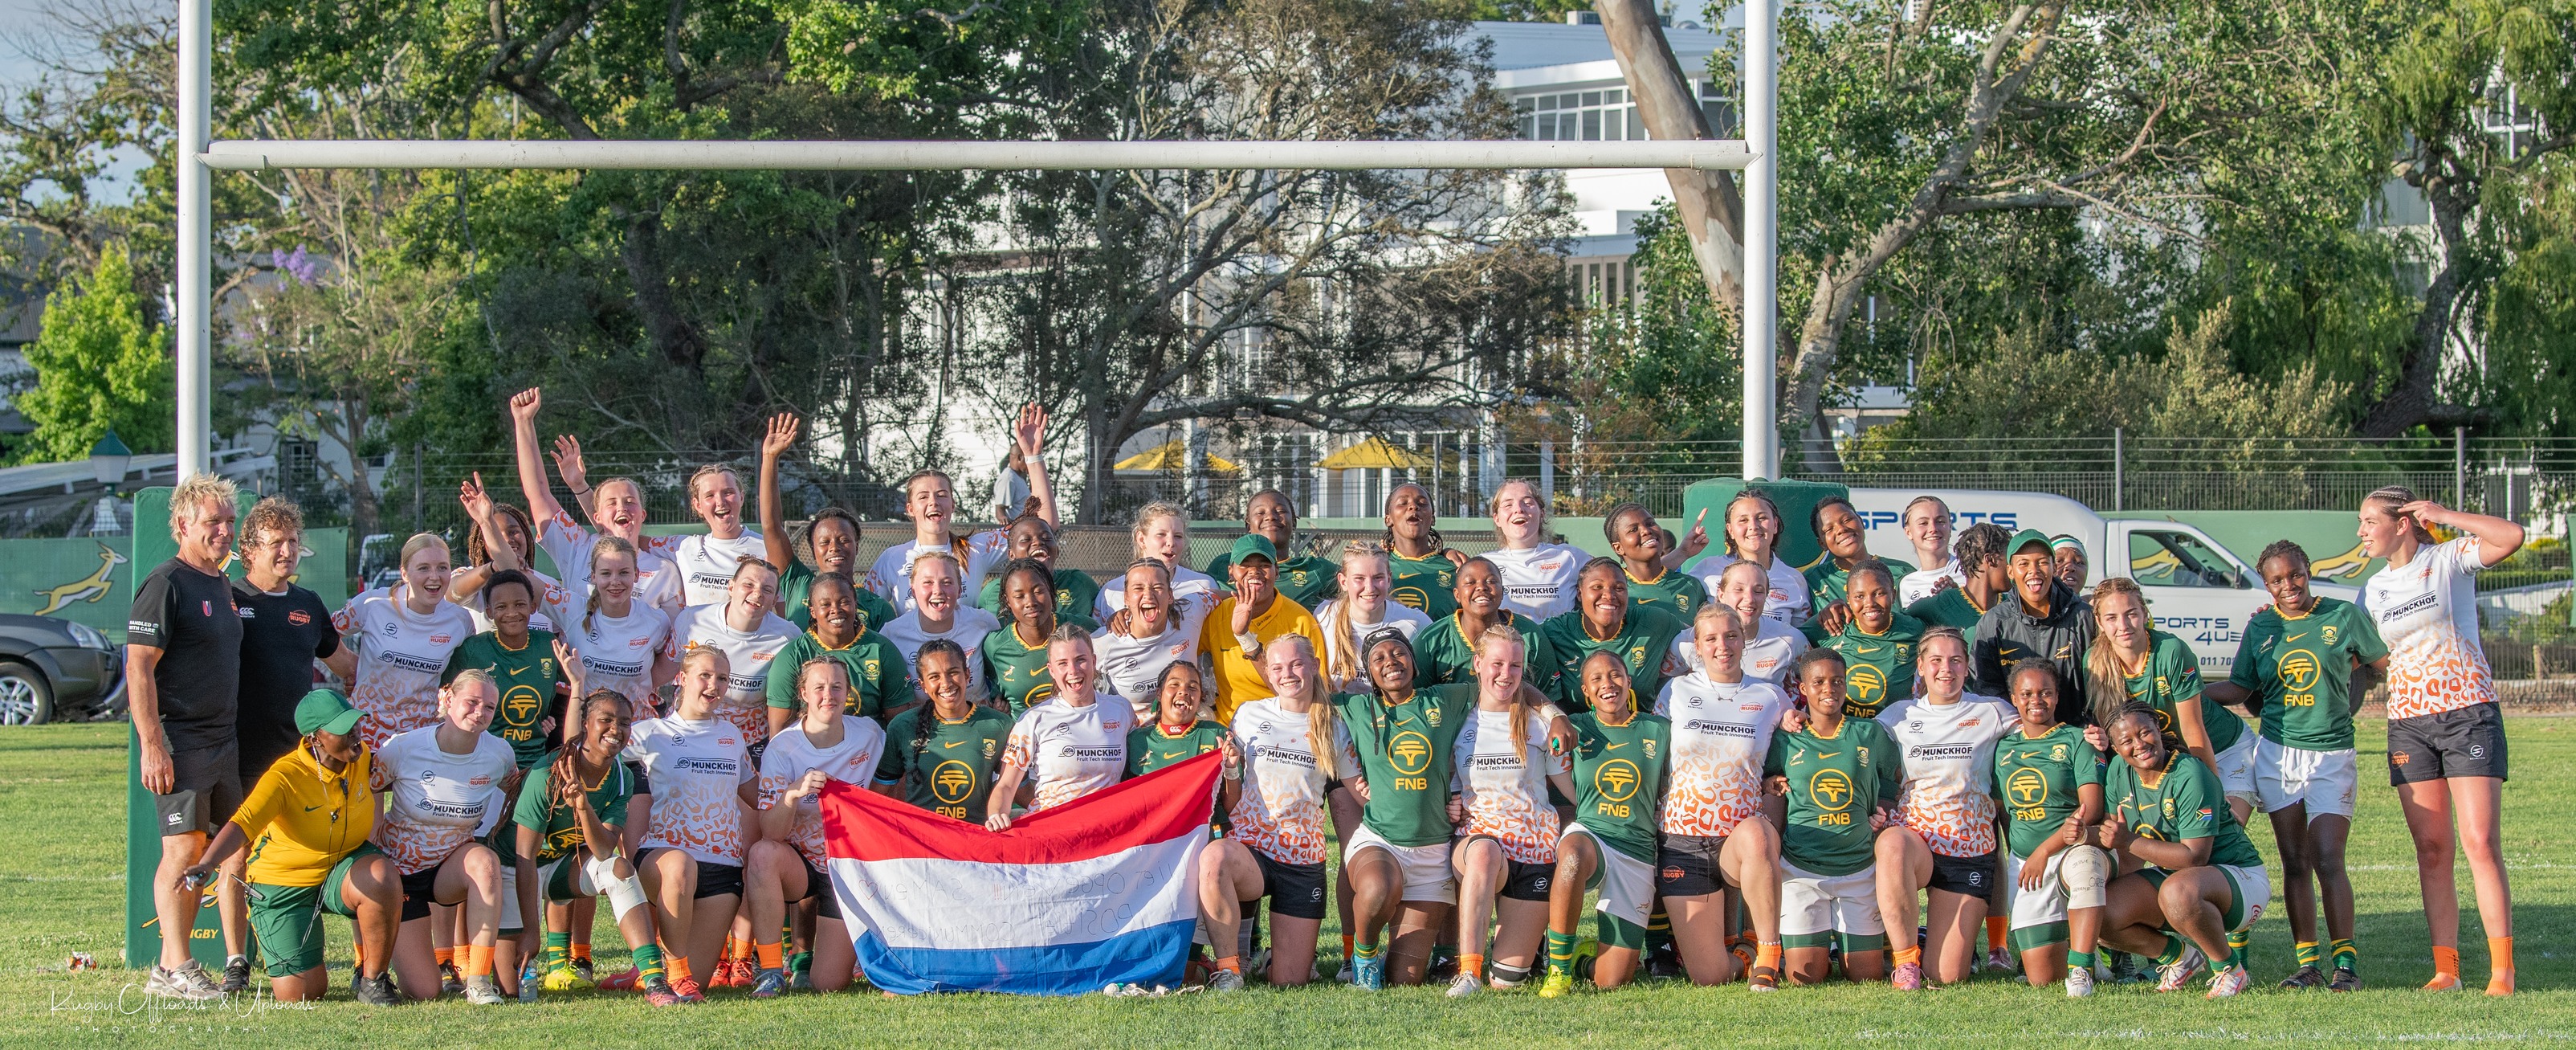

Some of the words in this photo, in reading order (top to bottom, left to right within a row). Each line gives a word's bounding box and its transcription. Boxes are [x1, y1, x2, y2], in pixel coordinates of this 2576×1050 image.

[701, 577, 730, 586] MUNCK
[1770, 593, 1789, 602] RUGBY
[2392, 595, 2437, 617] MUNCKHOF
[2414, 602, 2439, 615] Innovators
[290, 615, 310, 624] RUGBY
[2153, 617, 2229, 628] PORTS
[1172, 643, 1190, 656] RUGBY
[394, 657, 442, 670] MUNCKHOF
[2201, 657, 2216, 665] 011
[2221, 657, 2235, 665] 70
[594, 662, 643, 673] MUNCKHOF
[729, 678, 762, 687] NCKHOF
[2284, 695, 2315, 707] FNB
[1846, 705, 1876, 718] FNB
[1702, 723, 1756, 734] MUNCKHOF
[504, 729, 532, 741] FNB
[1923, 747, 1973, 756] MUNCKHOF
[850, 756, 869, 766] RUGBY
[1267, 750, 1317, 765] MUNCKHOF
[1477, 757, 1521, 766] MUNCKHO
[691, 761, 737, 770] MUNCKHOF
[1292, 761, 1316, 770] Innovators
[1395, 778, 1427, 790] FNB
[434, 804, 483, 814] MUNCKHOF
[935, 807, 967, 819] FNB
[1598, 803, 1630, 818] FNB
[2016, 807, 2046, 821] FNB
[1818, 813, 1850, 825] FNB
[537, 849, 565, 858] FN
[190, 929, 219, 939] GBY
